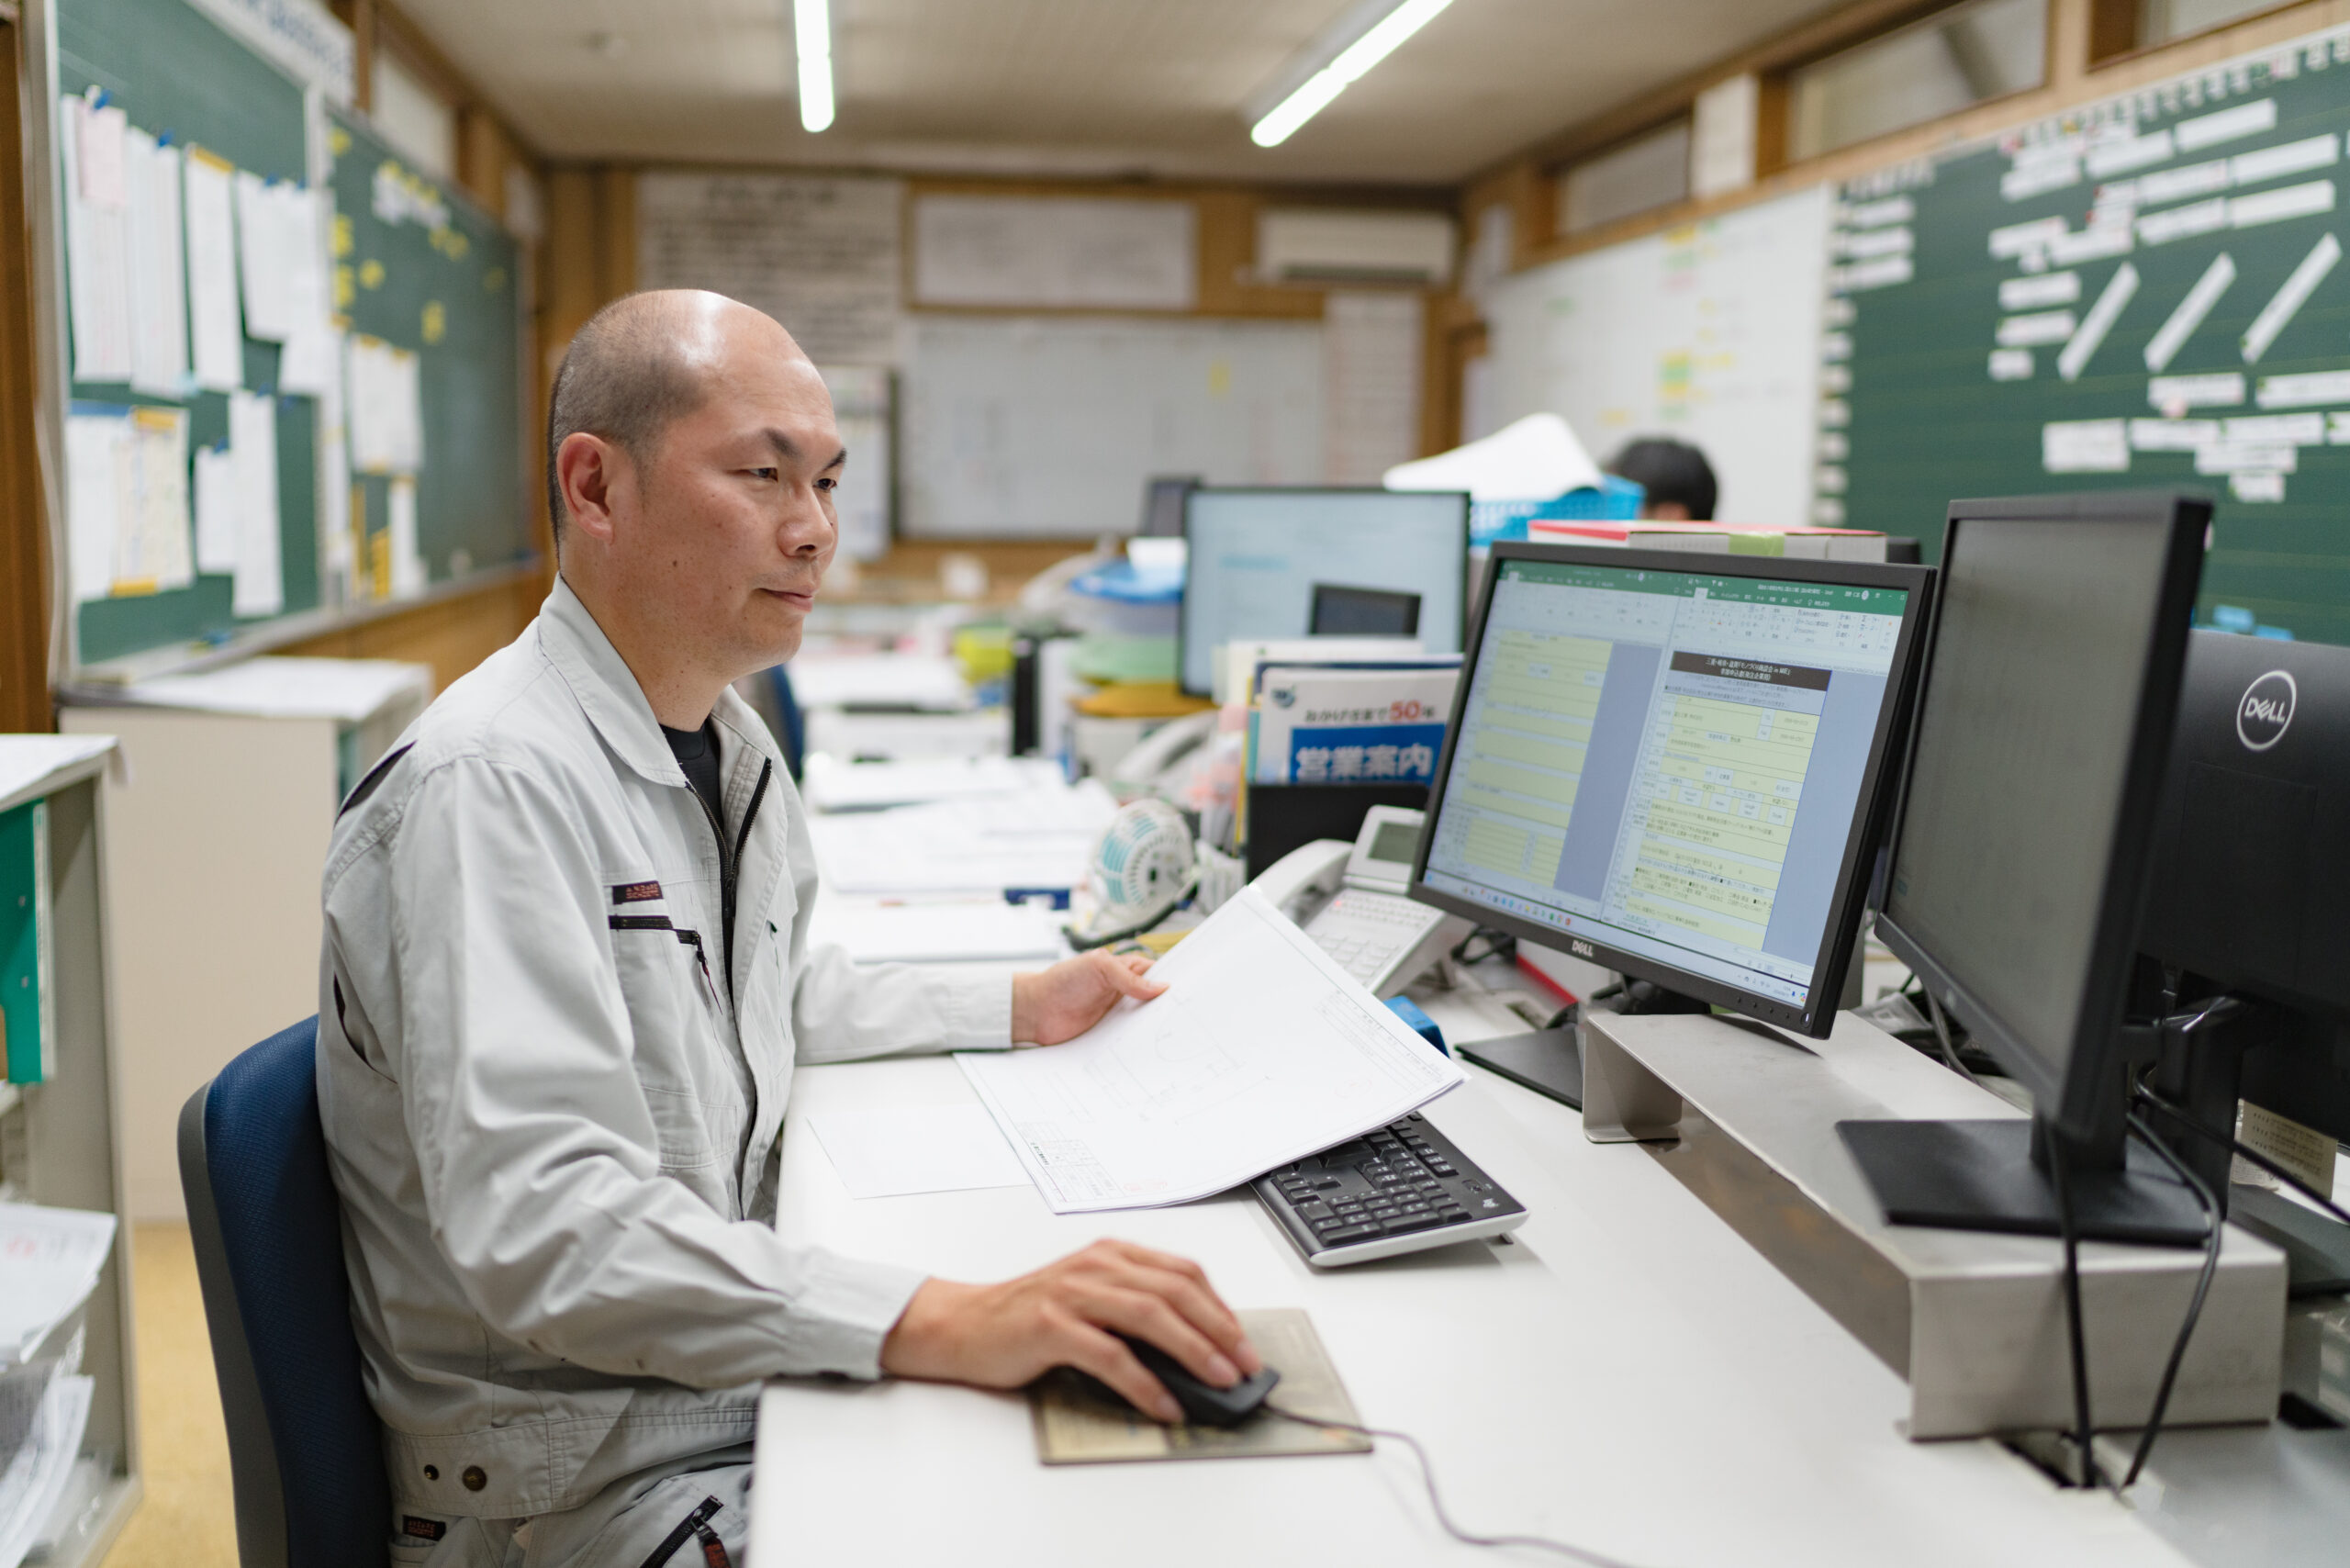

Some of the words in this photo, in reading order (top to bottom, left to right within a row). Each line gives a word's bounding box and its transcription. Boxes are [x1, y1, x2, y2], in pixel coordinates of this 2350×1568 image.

[2244, 697, 2286, 722] DELL
[1296, 743, 1433, 780] 営業案内
[1572, 939, 1594, 958] DELL
